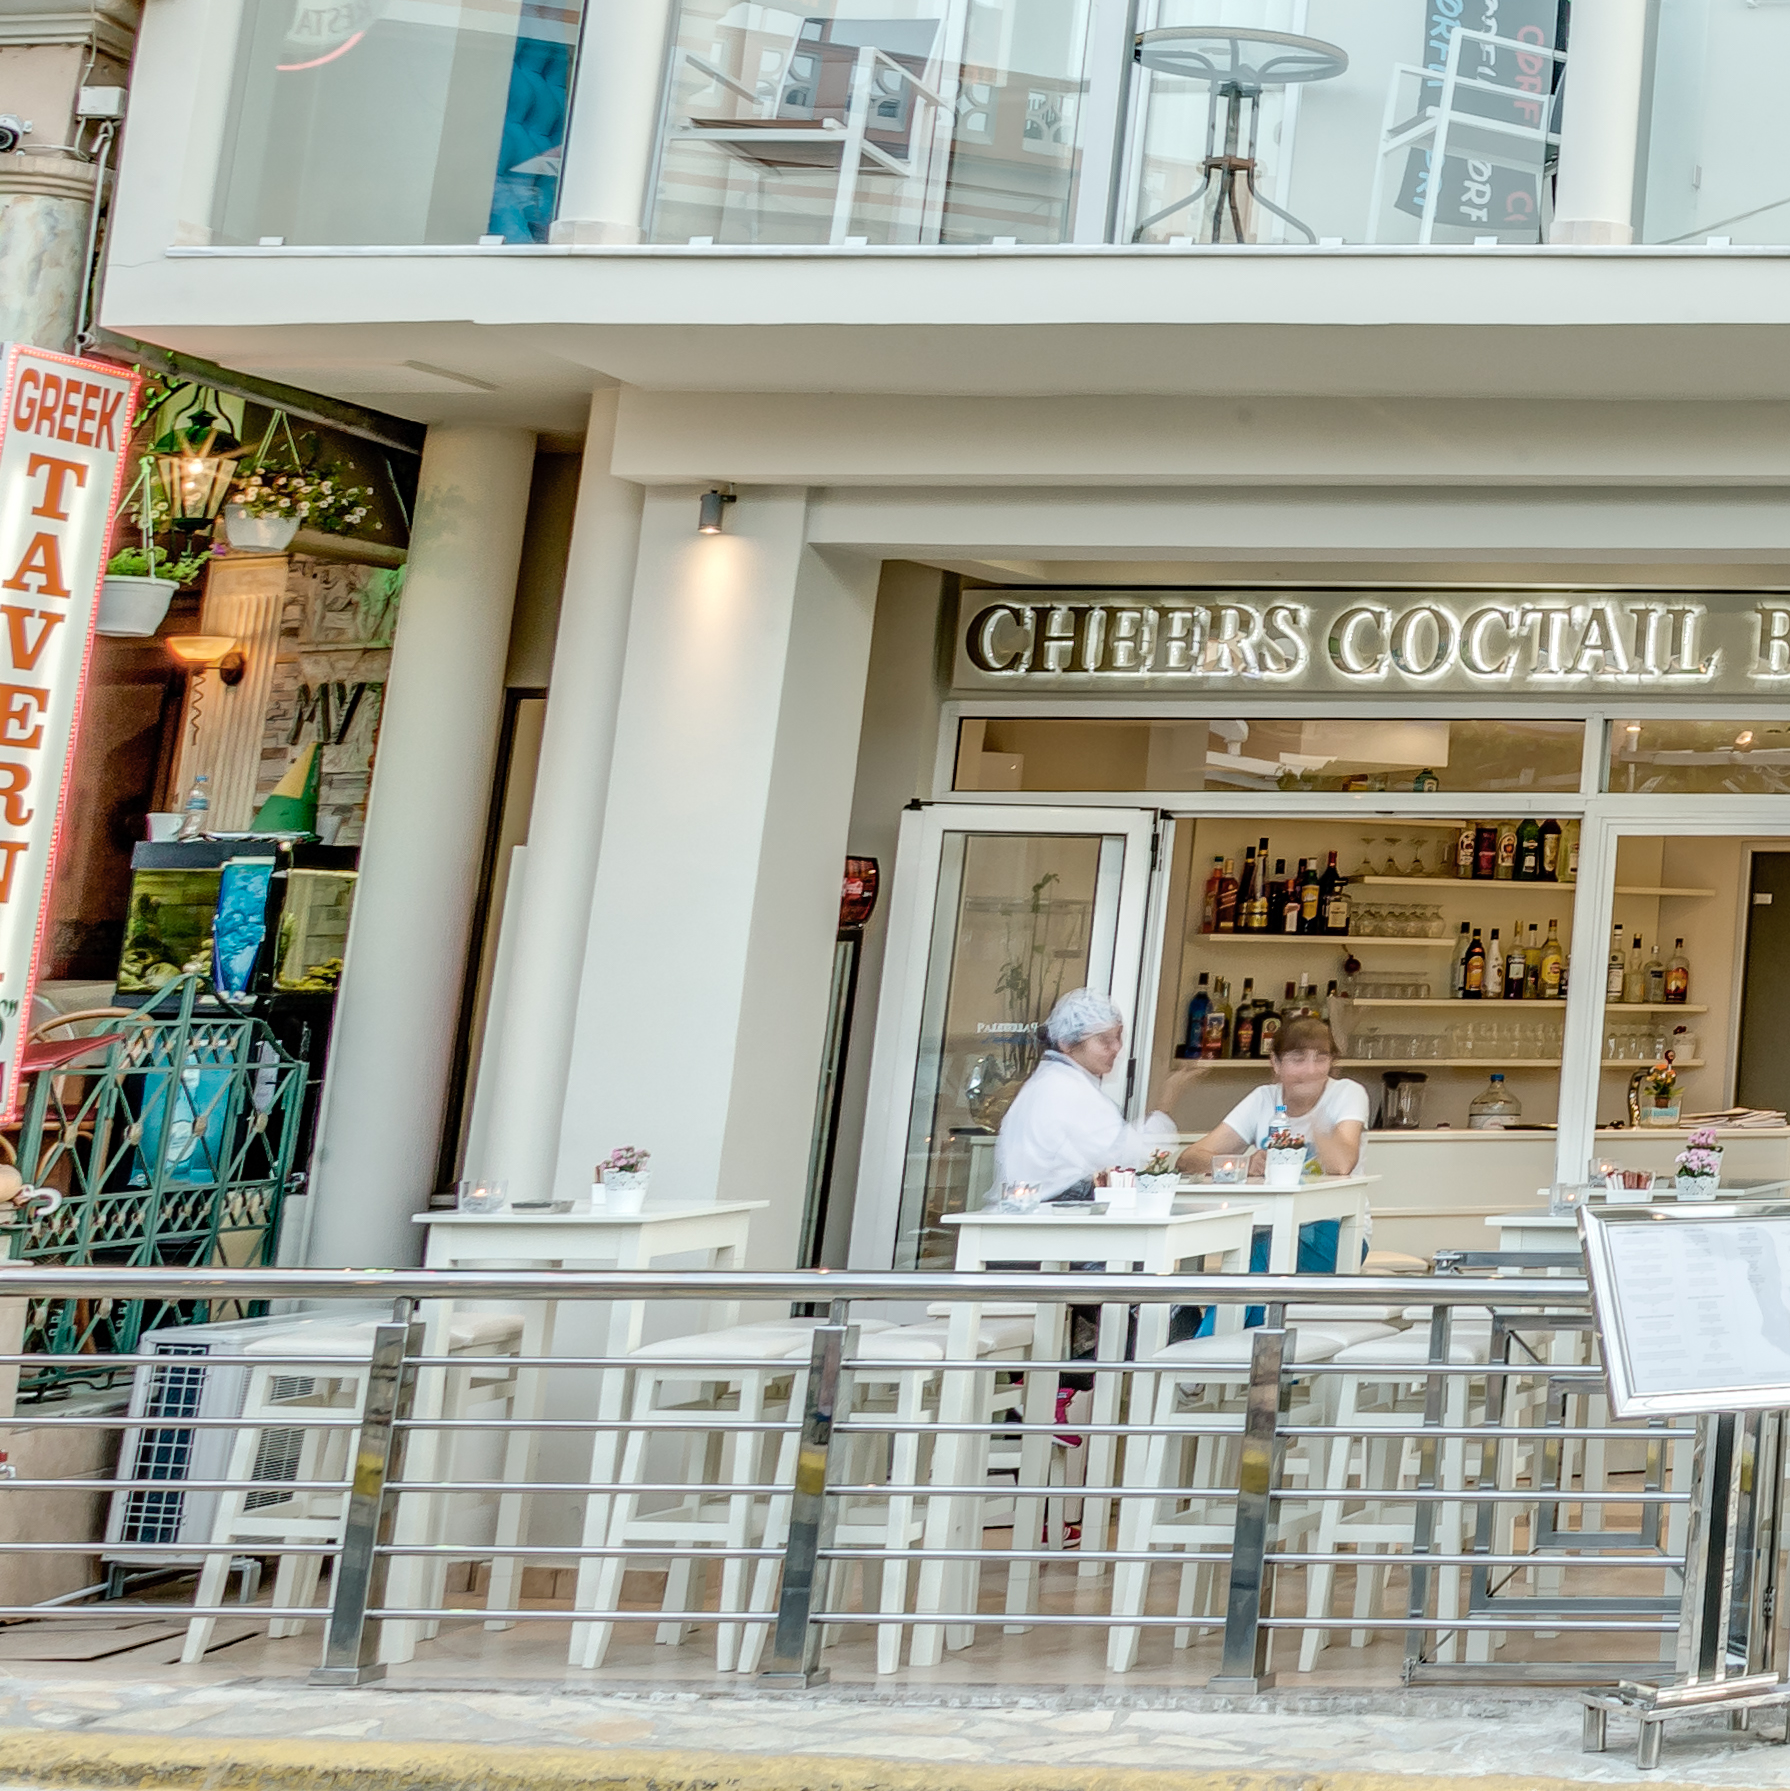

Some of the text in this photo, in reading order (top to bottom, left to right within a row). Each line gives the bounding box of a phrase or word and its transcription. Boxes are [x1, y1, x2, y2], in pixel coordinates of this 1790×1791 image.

[12, 367, 124, 452] GREEK
[966, 602, 1309, 676] CHEERS
[1329, 604, 1714, 679] COCTAIL
